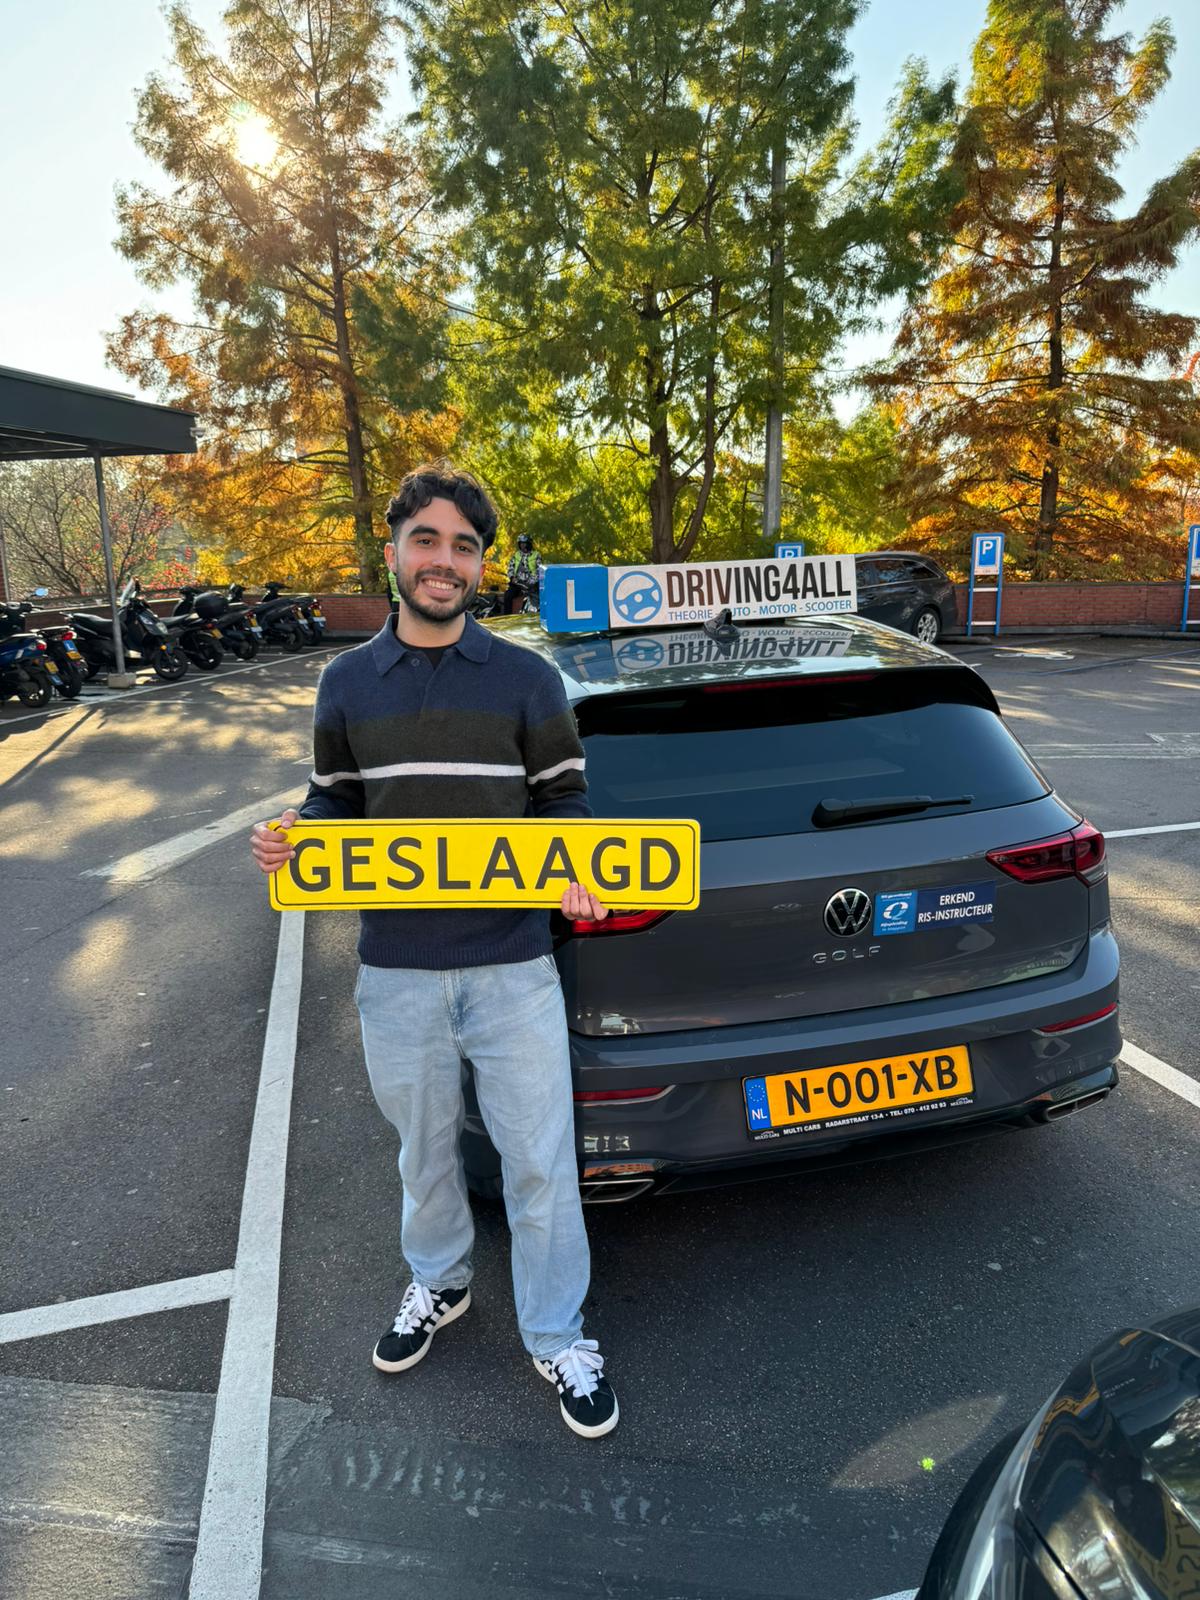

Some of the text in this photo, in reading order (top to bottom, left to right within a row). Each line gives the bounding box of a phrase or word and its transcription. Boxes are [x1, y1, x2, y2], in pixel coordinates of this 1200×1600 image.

[982, 541, 994, 555] P
[666, 560, 852, 608] DRIVING4ALL
[566, 579, 593, 620] L
[668, 609, 713, 622] THEORIE
[732, 606, 751, 617] UTO
[759, 603, 797, 616] MOTOR
[805, 600, 852, 612] SCOOTER
[288, 836, 681, 892] GESLAAGD
[939, 891, 975, 906] ERKEND
[917, 903, 994, 923] RIS-INSTRUCTEUR
[812, 945, 881, 964] GOLF
[784, 1055, 958, 1116] N-001-XB
[751, 1108, 768, 1120] NL
[783, 1126, 803, 1135] MULTI
[803, 1123, 821, 1132] CARS
[825, 1115, 870, 1128] RADARSTRAAT
[919, 1104, 931, 1112] 412
